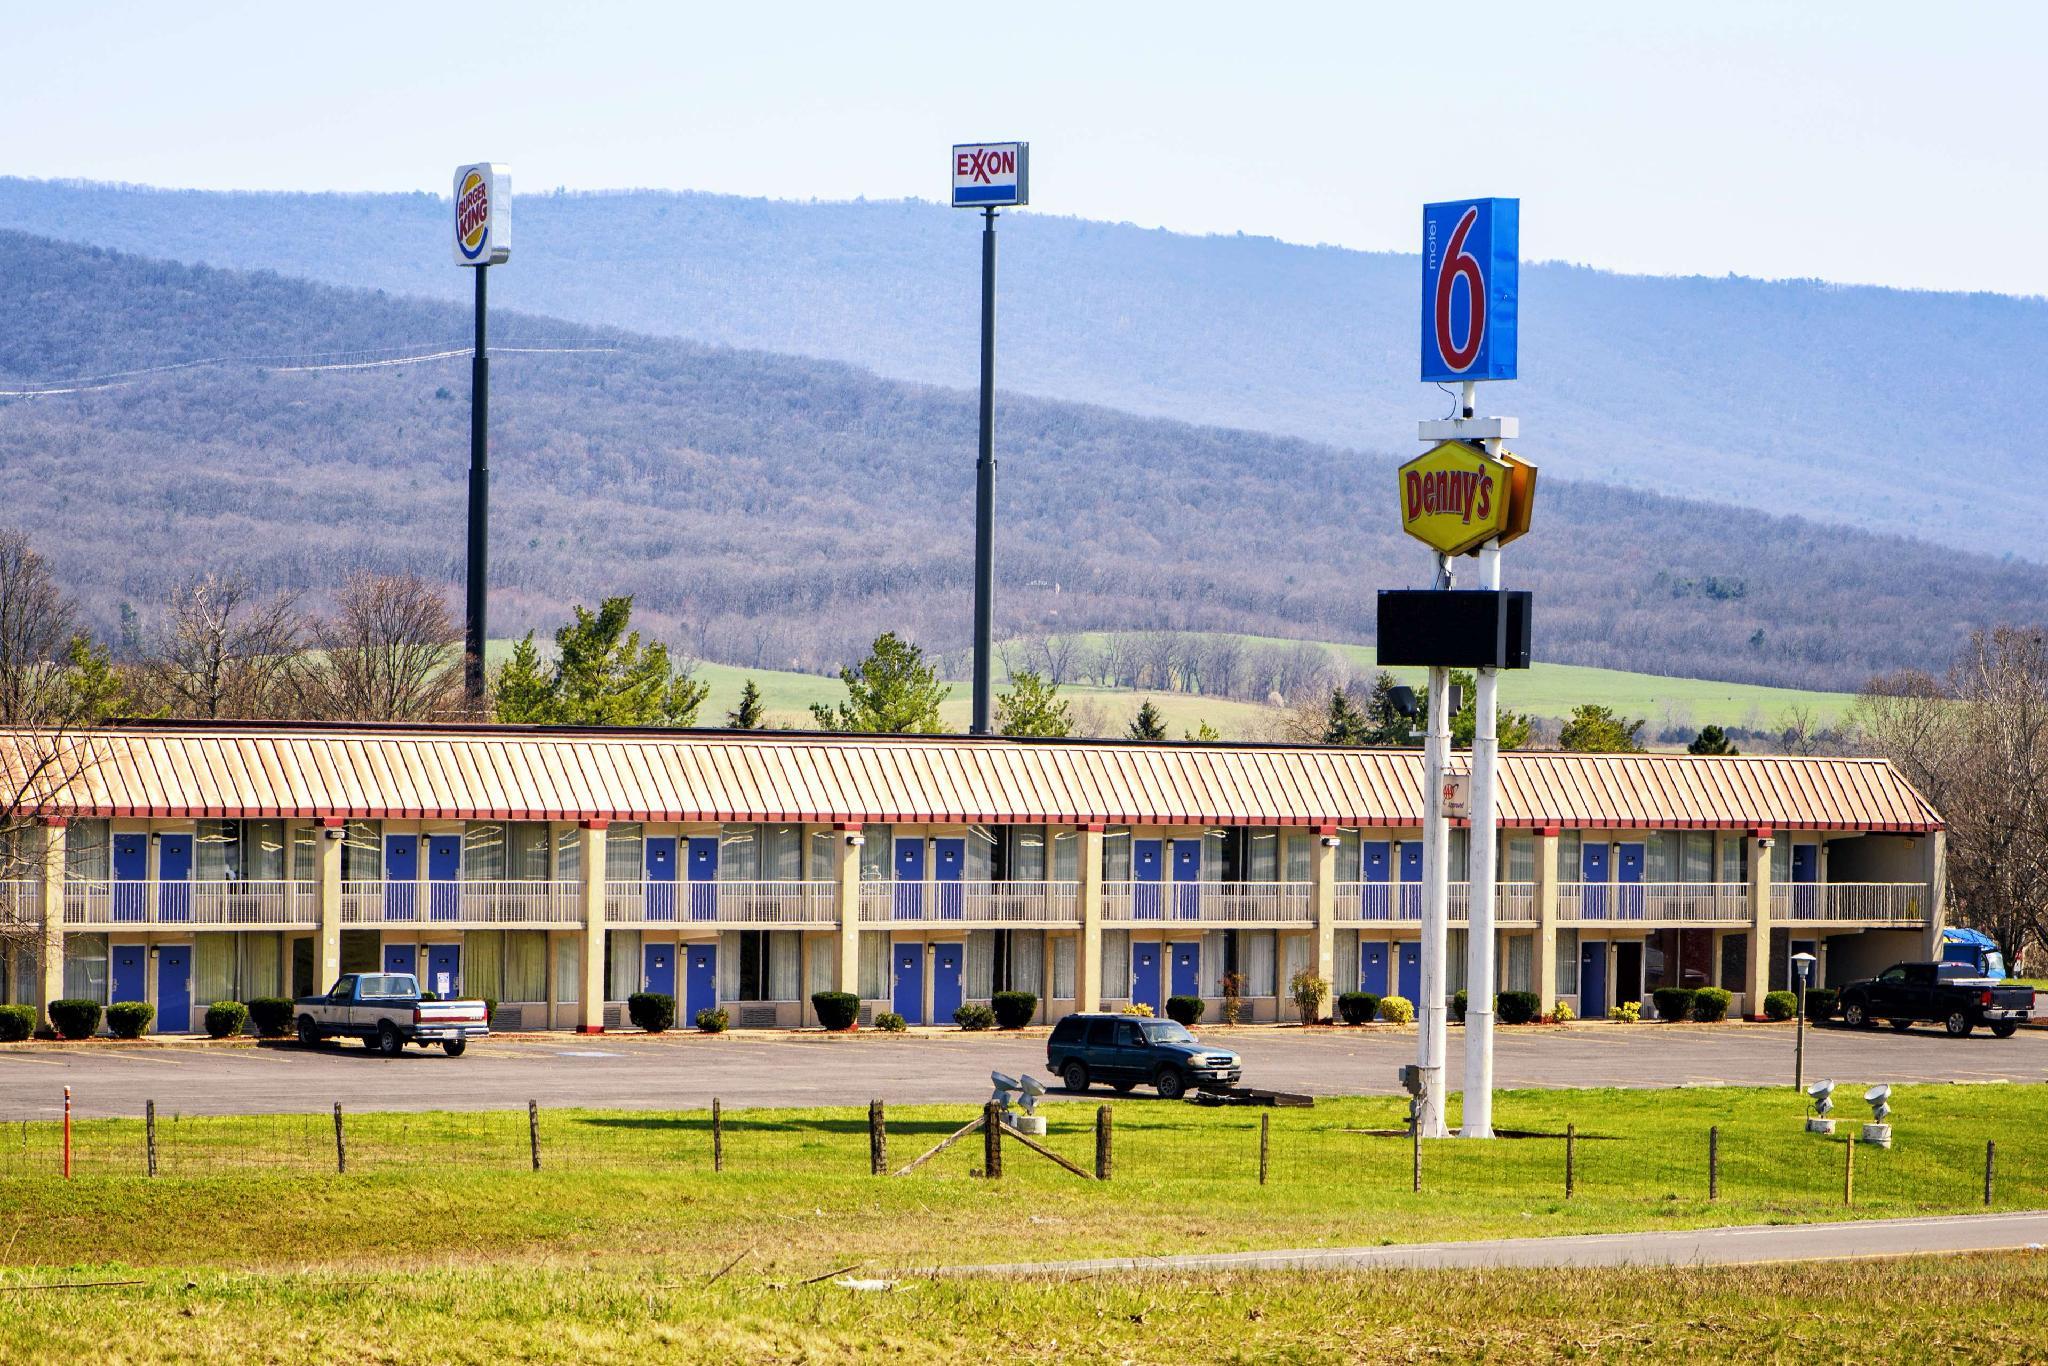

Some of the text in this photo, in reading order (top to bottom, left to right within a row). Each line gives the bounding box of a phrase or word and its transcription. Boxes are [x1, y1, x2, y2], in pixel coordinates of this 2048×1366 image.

[957, 148, 1015, 184] EXXON
[459, 183, 486, 219] BURGER
[460, 198, 488, 241] KING
[1429, 220, 1437, 270] motel
[1435, 205, 1486, 373] 6
[1406, 463, 1493, 525] Denny's
